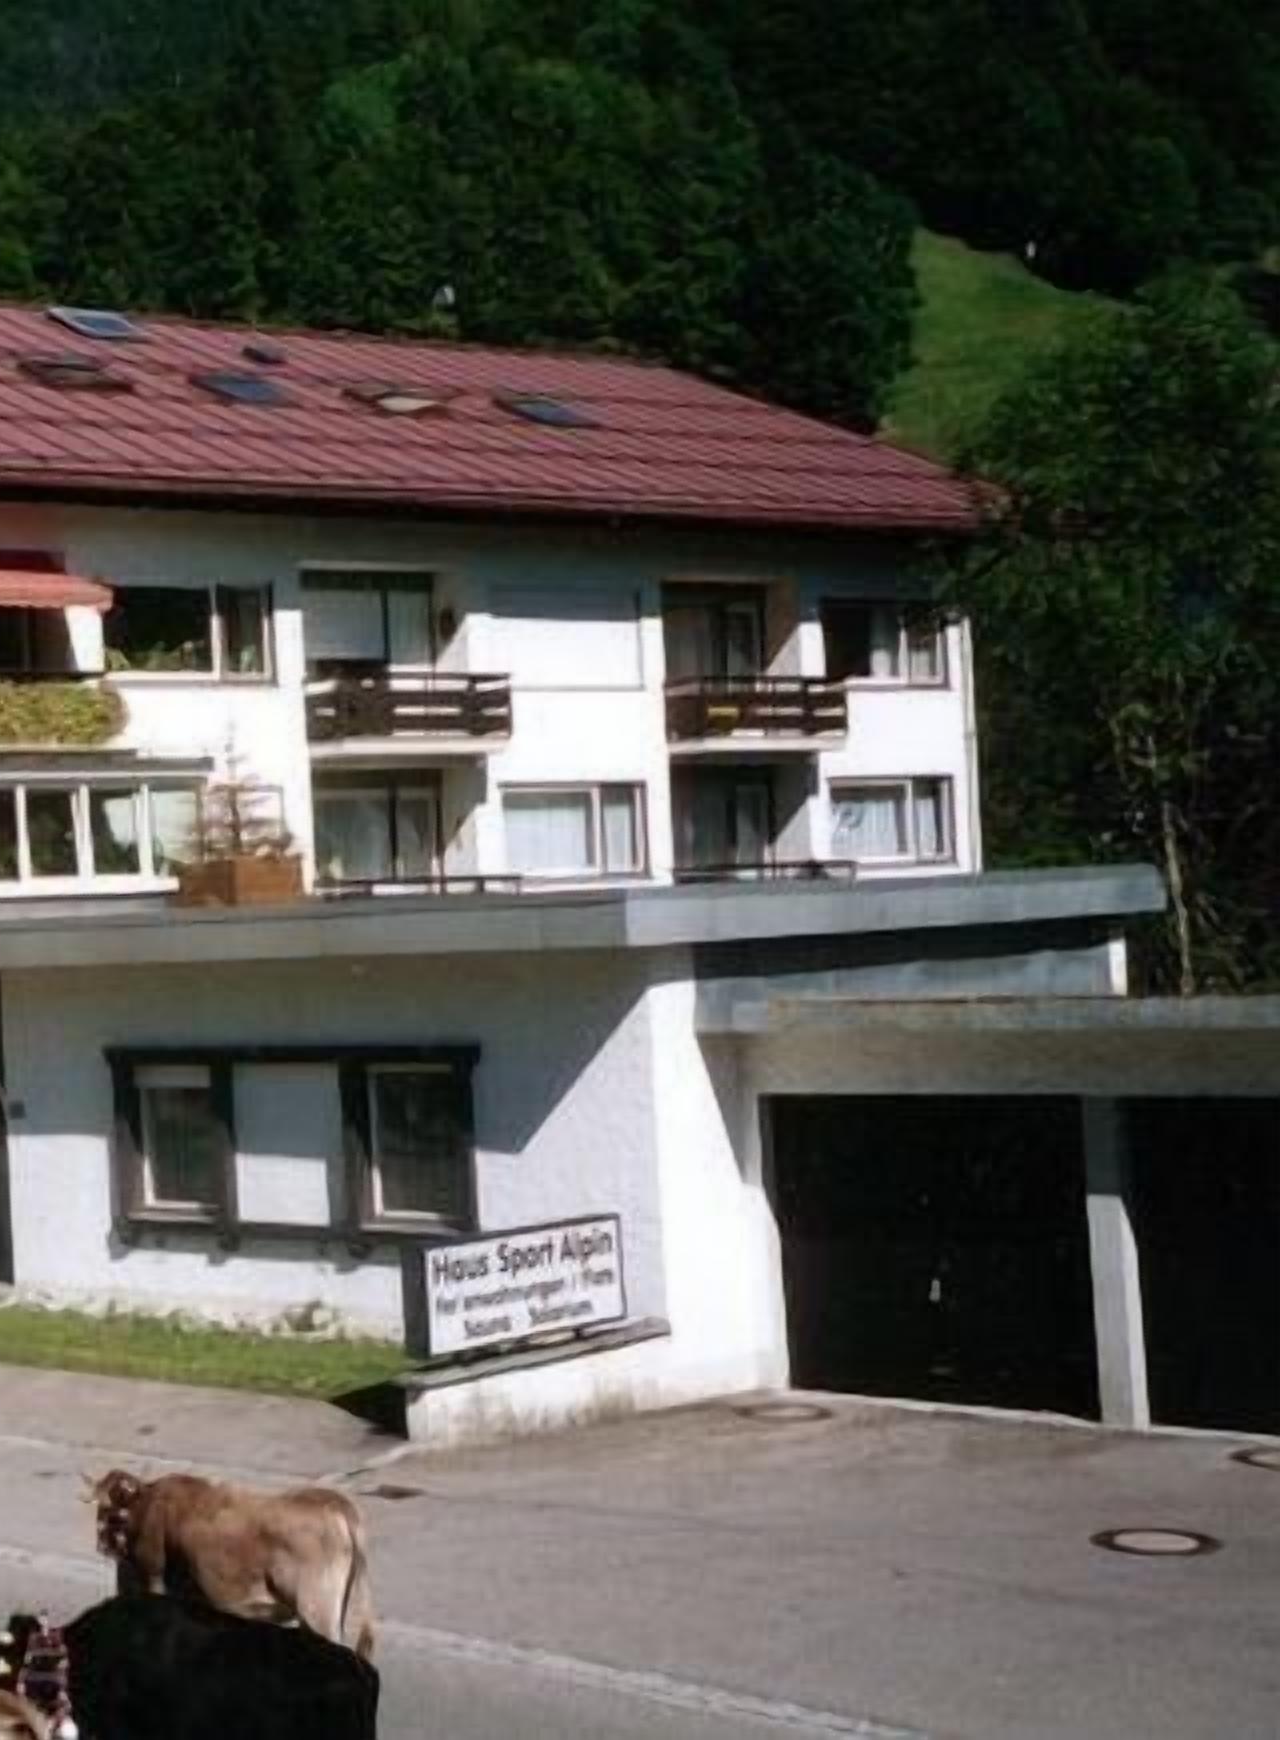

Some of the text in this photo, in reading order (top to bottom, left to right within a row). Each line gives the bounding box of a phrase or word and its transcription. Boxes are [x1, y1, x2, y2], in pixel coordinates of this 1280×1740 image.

[433, 1228, 613, 1284] Haus Sport Alpin
